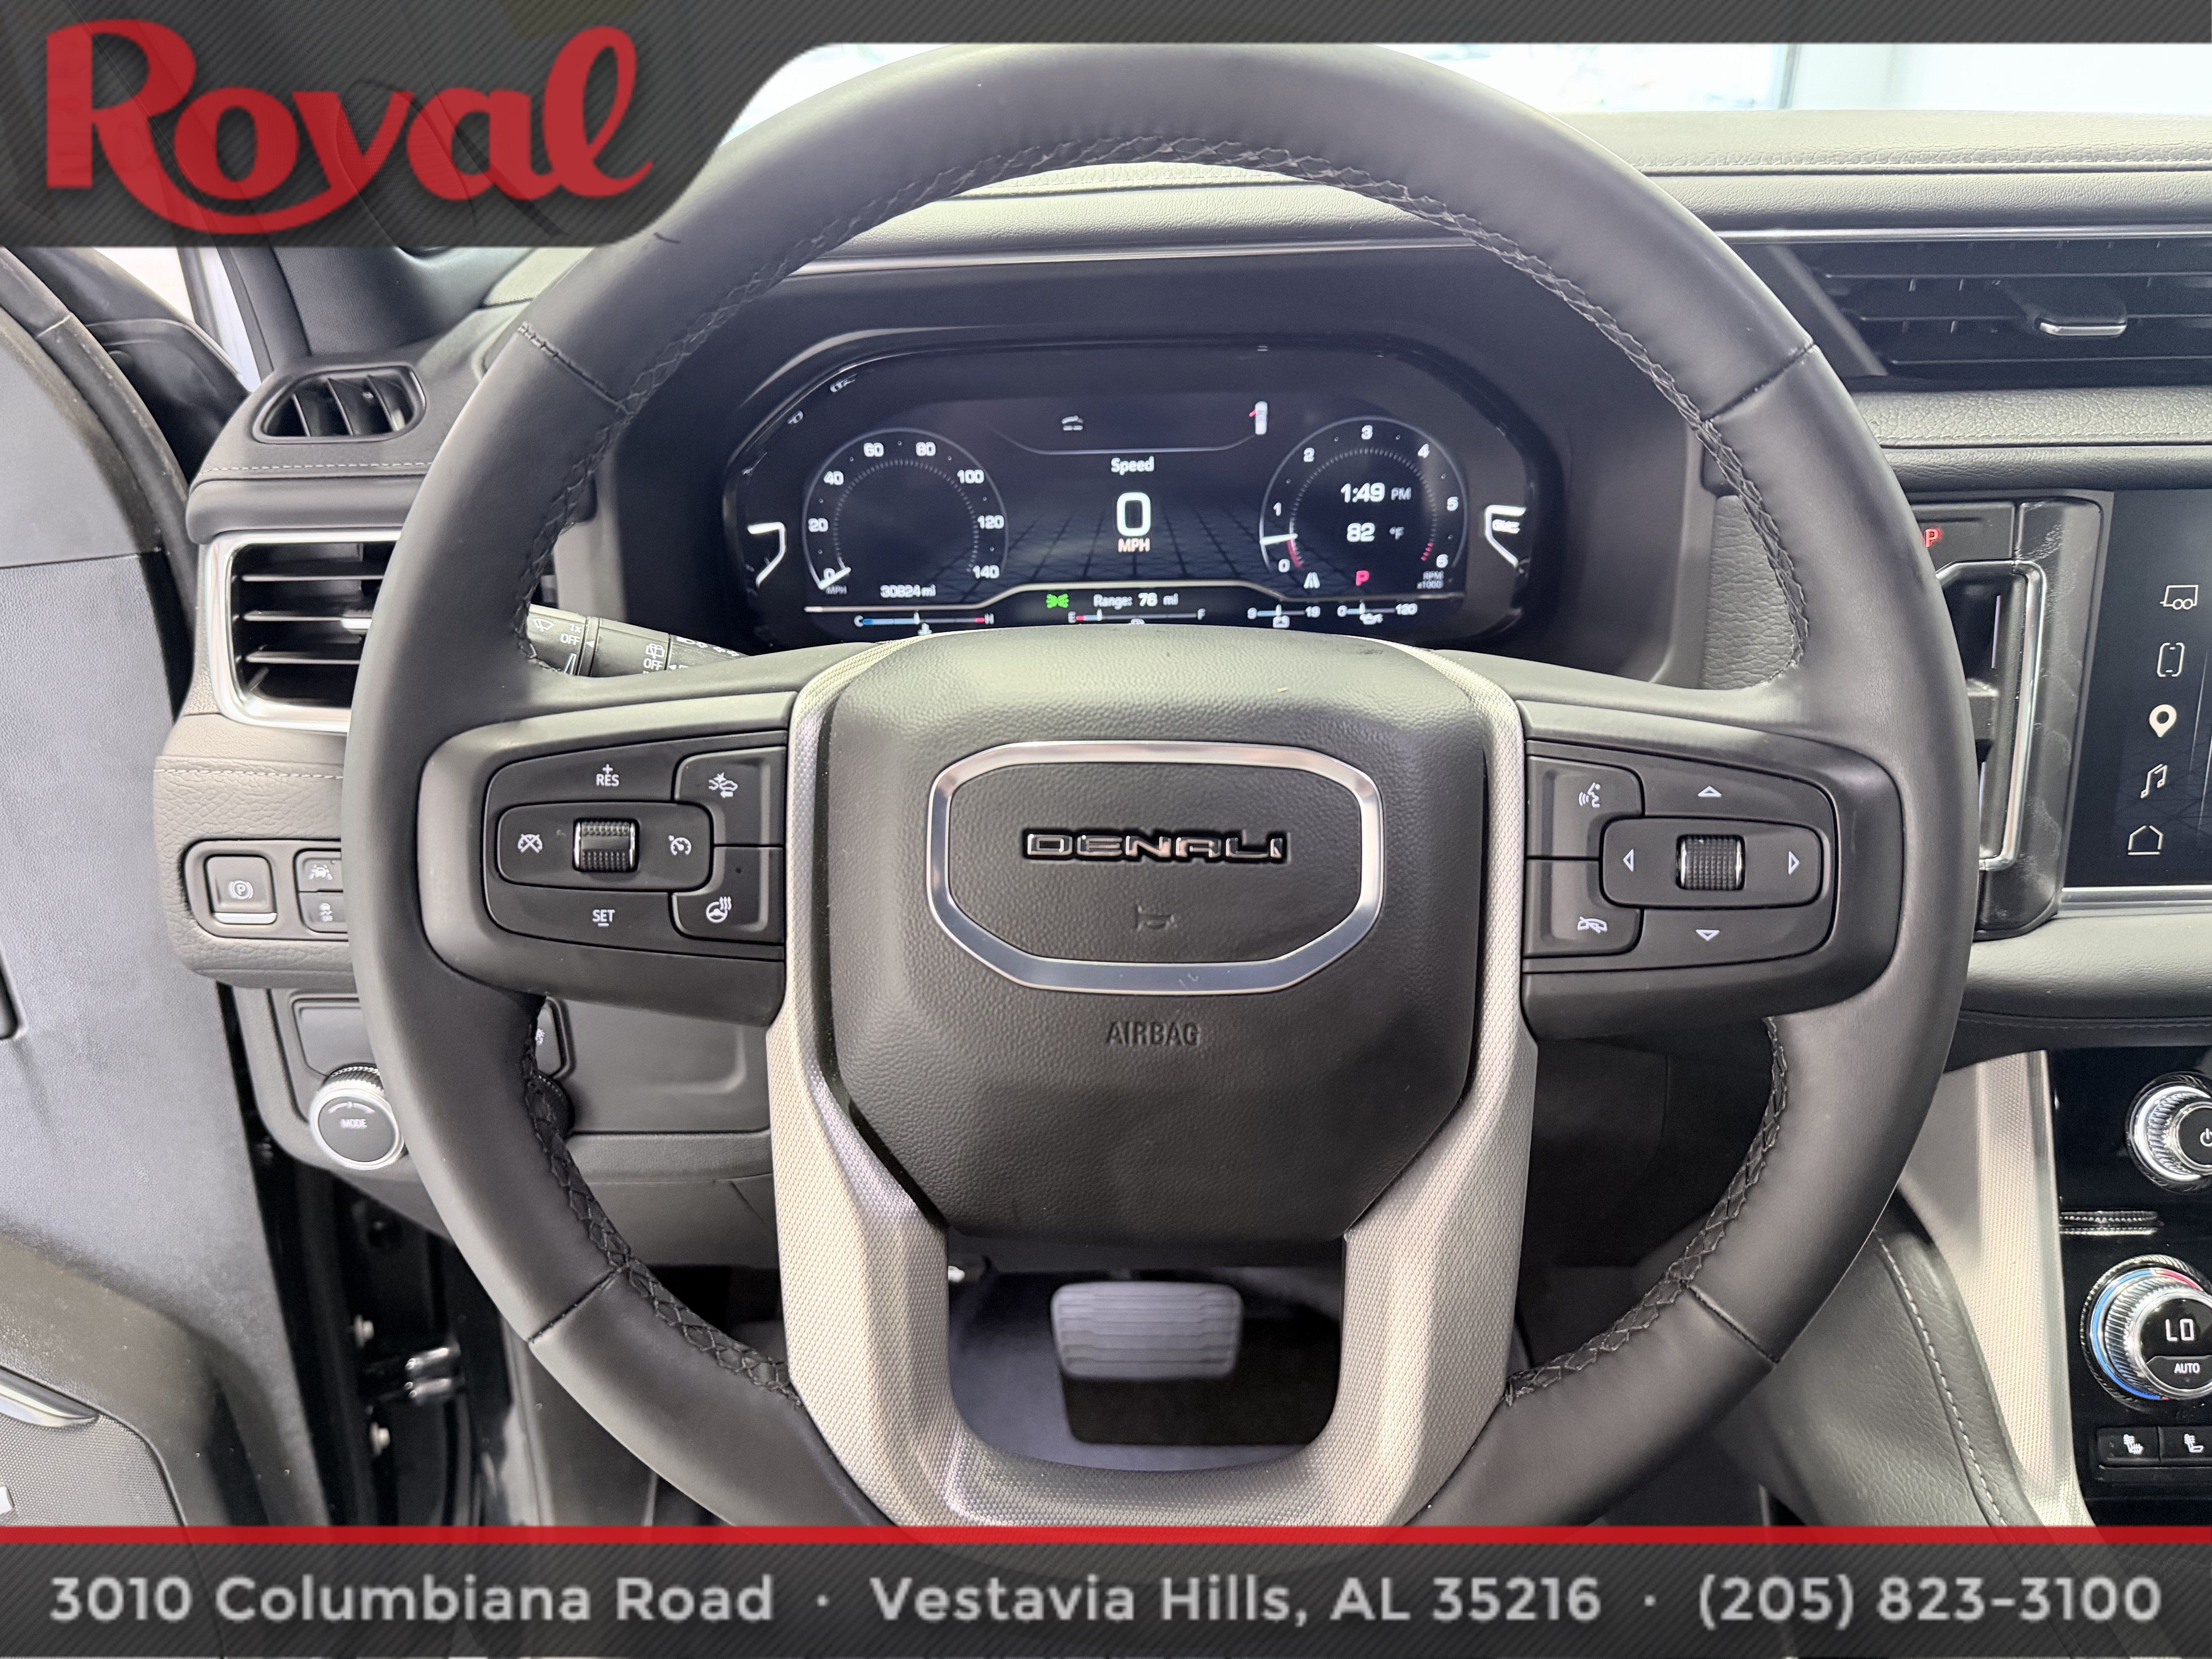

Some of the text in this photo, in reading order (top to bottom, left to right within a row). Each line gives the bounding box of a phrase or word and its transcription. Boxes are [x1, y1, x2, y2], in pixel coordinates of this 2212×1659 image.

[1361, 425, 1372, 440] 3
[864, 442, 884, 457] 60
[915, 441, 936, 456] 80
[1304, 447, 1315, 462] 2
[1418, 443, 1430, 458] 4
[1111, 456, 1154, 475] Speed
[823, 471, 844, 485] 40
[957, 469, 984, 484] 100
[1340, 483, 1412, 503] 1:49 PM
[1273, 502, 1282, 516] 1
[1447, 496, 1459, 511] 5
[1117, 492, 1151, 536] 0
[808, 518, 829, 532] 20
[977, 515, 1004, 529] 120
[1346, 523, 1376, 542] 82
[1926, 529, 1940, 547] P
[1118, 538, 1150, 553] MPH
[1278, 559, 1290, 572] 0
[1436, 554, 1449, 568] 6
[972, 565, 1000, 579] 140
[1356, 570, 1370, 586] P
[1423, 571, 1444, 581] RPM
[1094, 592, 1178, 610] Range: 76 mi
[1396, 603, 1418, 615] 120
[560, 634, 580, 646] OFF
[643, 658, 663, 670] OFF
[596, 774, 619, 787] RES
[1027, 833, 1283, 858] DENALI
[592, 909, 615, 922] SET
[1105, 1021, 1200, 1046] AIRBAG
[340, 1118, 367, 1128] MODE
[2166, 1319, 2194, 1342] LO
[2174, 1363, 2200, 1374] AUTO
